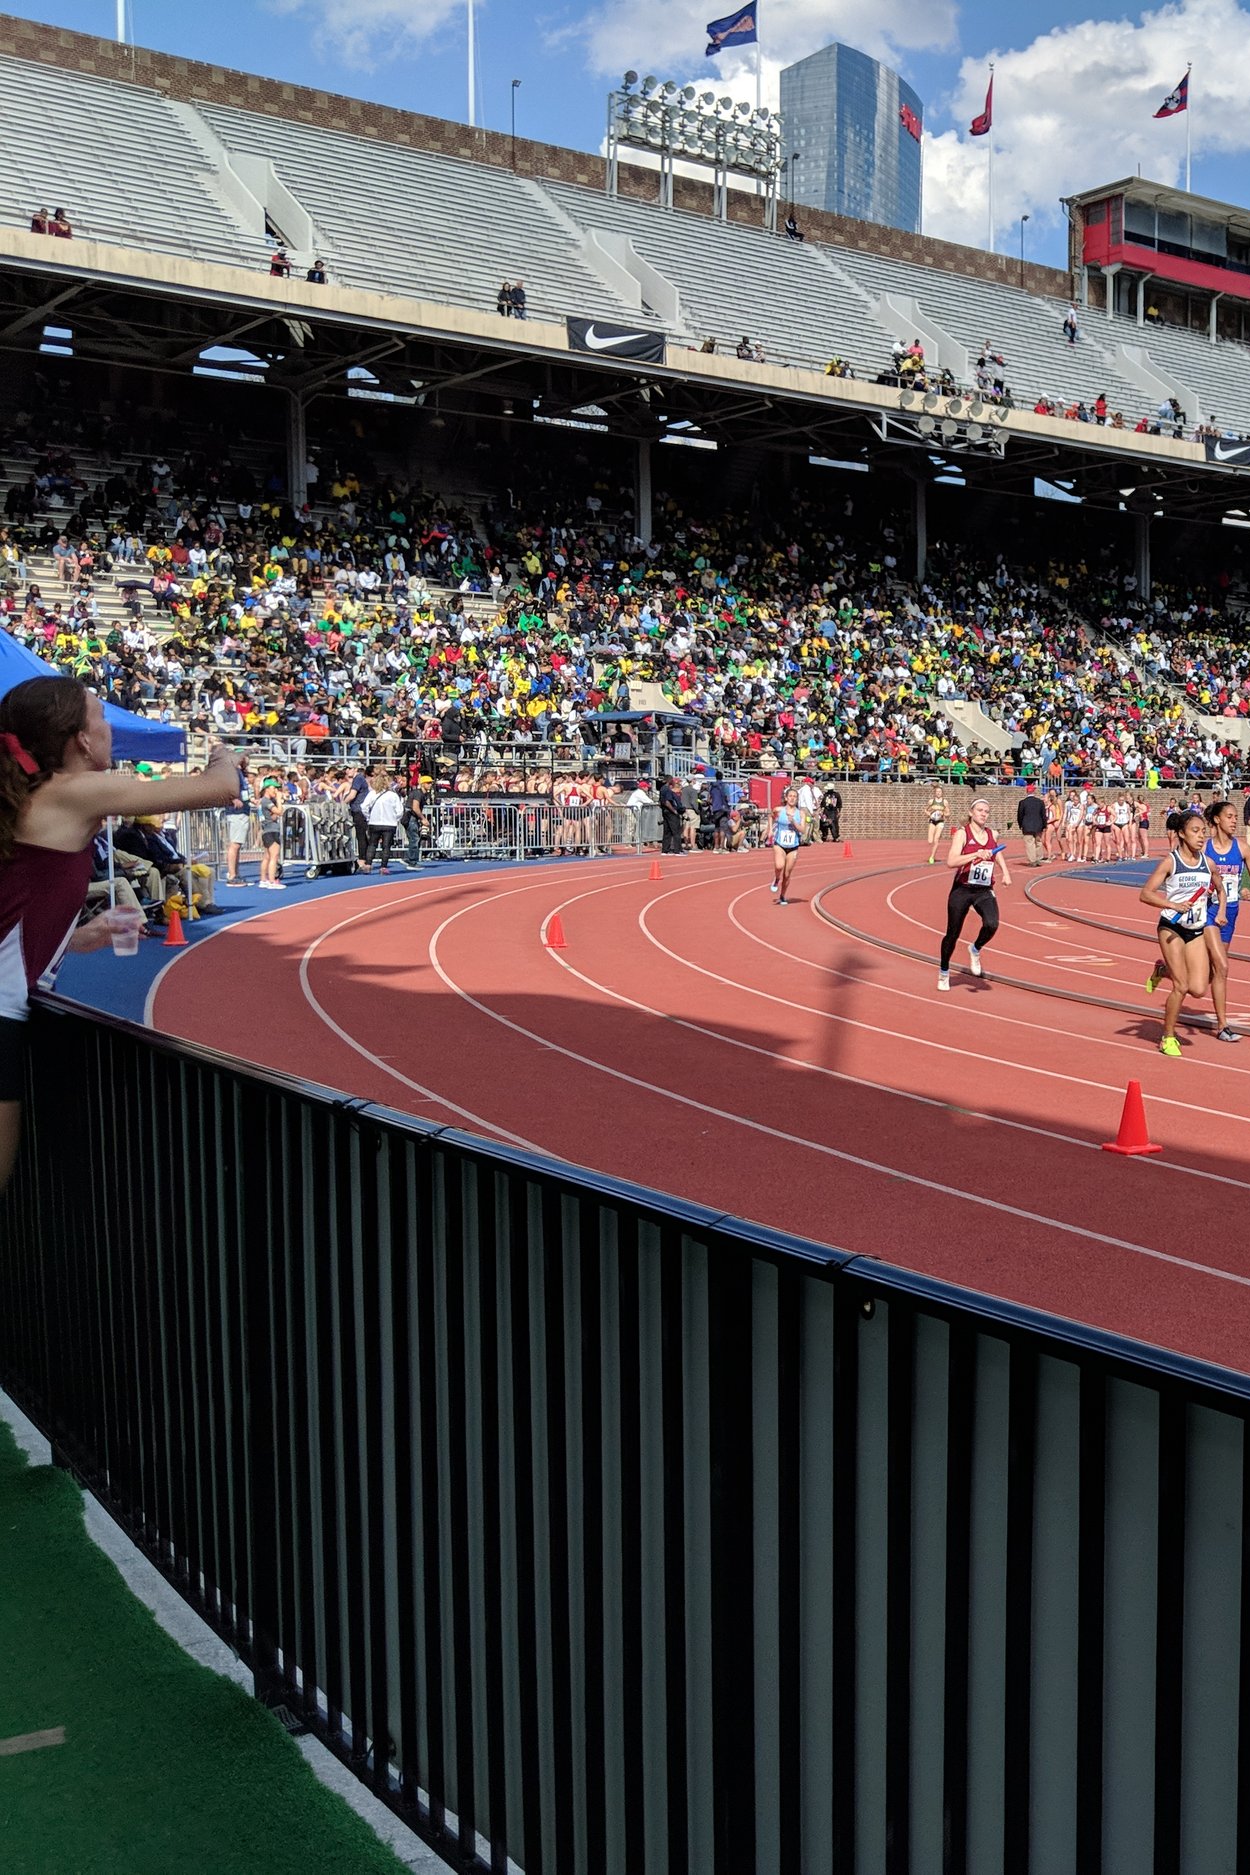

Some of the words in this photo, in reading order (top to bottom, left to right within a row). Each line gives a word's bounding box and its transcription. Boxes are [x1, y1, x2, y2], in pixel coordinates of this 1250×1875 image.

[783, 833, 793, 844] AY
[973, 867, 989, 881] BC
[1178, 881, 1209, 889] WASHINGTON
[1226, 881, 1233, 897] F
